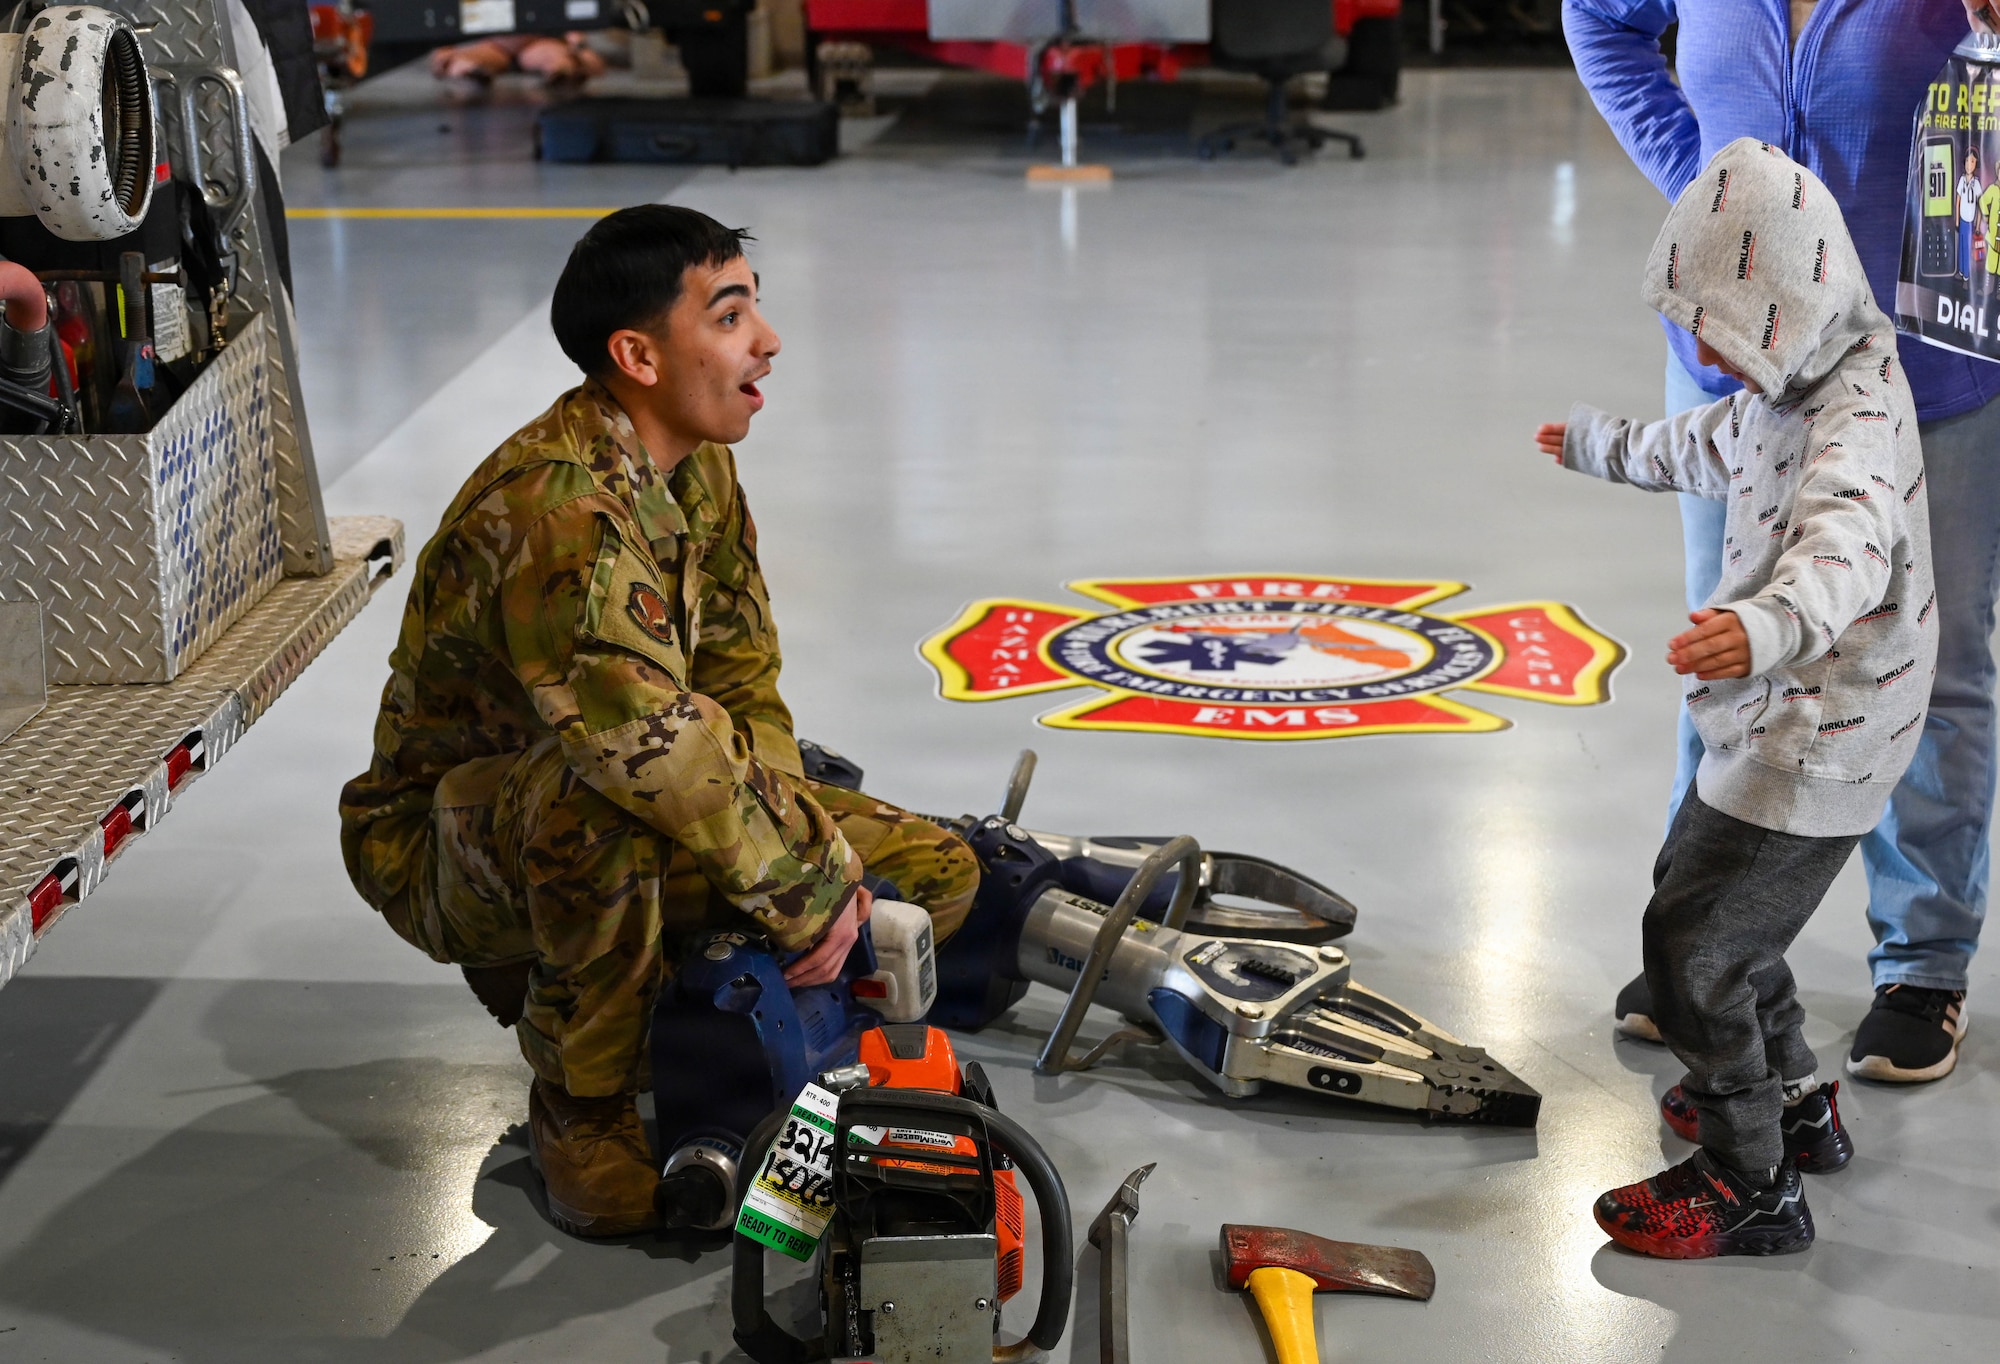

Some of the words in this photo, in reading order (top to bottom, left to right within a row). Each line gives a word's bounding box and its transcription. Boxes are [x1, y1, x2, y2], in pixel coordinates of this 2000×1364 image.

[1928, 83, 1950, 112] TO
[1935, 115, 1957, 130] FIRE
[1960, 116, 1972, 130] OR
[1711, 169, 1727, 213] KIRKLAND
[1792, 172, 1802, 210] KIRKLAND
[1929, 172, 1946, 198] 911
[1667, 242, 1677, 290] KIRKLAND
[1737, 230, 1752, 280] KIRKLAND
[1813, 238, 1825, 283] KIRKLAND
[1691, 306, 1704, 336] KLAND
[1761, 303, 1777, 350] KIRKLAND
[1937, 294, 1989, 338] DIAL
[1833, 488, 1869, 499] KIRKLA
[1188, 582, 1351, 598] FIRE
[1291, 602, 1424, 631] FIELD
[1100, 670, 1350, 701] EMERGENCY
[1361, 650, 1486, 697] SERVICES
[1876, 659, 1915, 685] KIRKLAND
[1782, 685, 1821, 699] KIRKLAND
[1192, 706, 1360, 725] EMS
[1818, 715, 1866, 733] KIRKLAND
[1890, 711, 1921, 742] KIRKLAND
[804, 1090, 817, 1101] RTR
[819, 1097, 831, 1108] 400
[795, 1108, 826, 1127] READY
[890, 1132, 953, 1147] VentMaster
[740, 1213, 772, 1237] READY
[774, 1227, 787, 1244] TO
[786, 1235, 812, 1257] RENT
